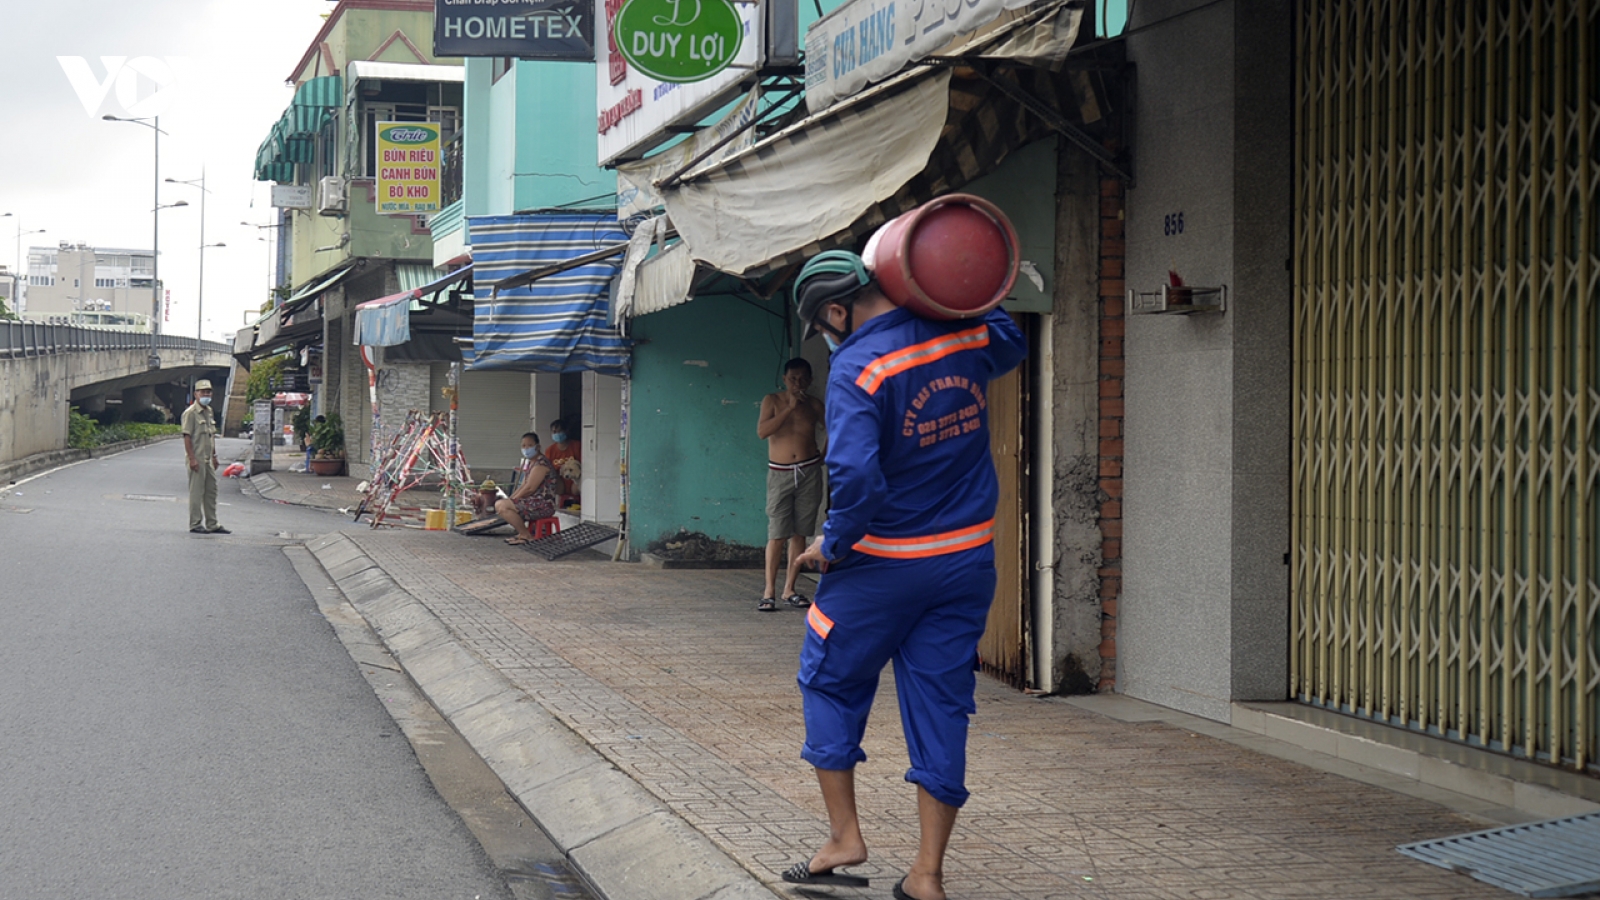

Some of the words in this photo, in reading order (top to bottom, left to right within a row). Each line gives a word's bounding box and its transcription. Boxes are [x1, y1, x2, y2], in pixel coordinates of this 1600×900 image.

[444, 14, 583, 39] HOMETEX
[633, 31, 682, 58] DUY
[689, 32, 724, 66] LỢI
[383, 147, 406, 162] BÚN
[381, 168, 411, 180] CANH
[414, 166, 437, 180] BÚN
[407, 185, 429, 198] KHO
[1164, 212, 1184, 236] 856
[902, 409, 917, 436] CTY
[911, 387, 930, 409] GAS
